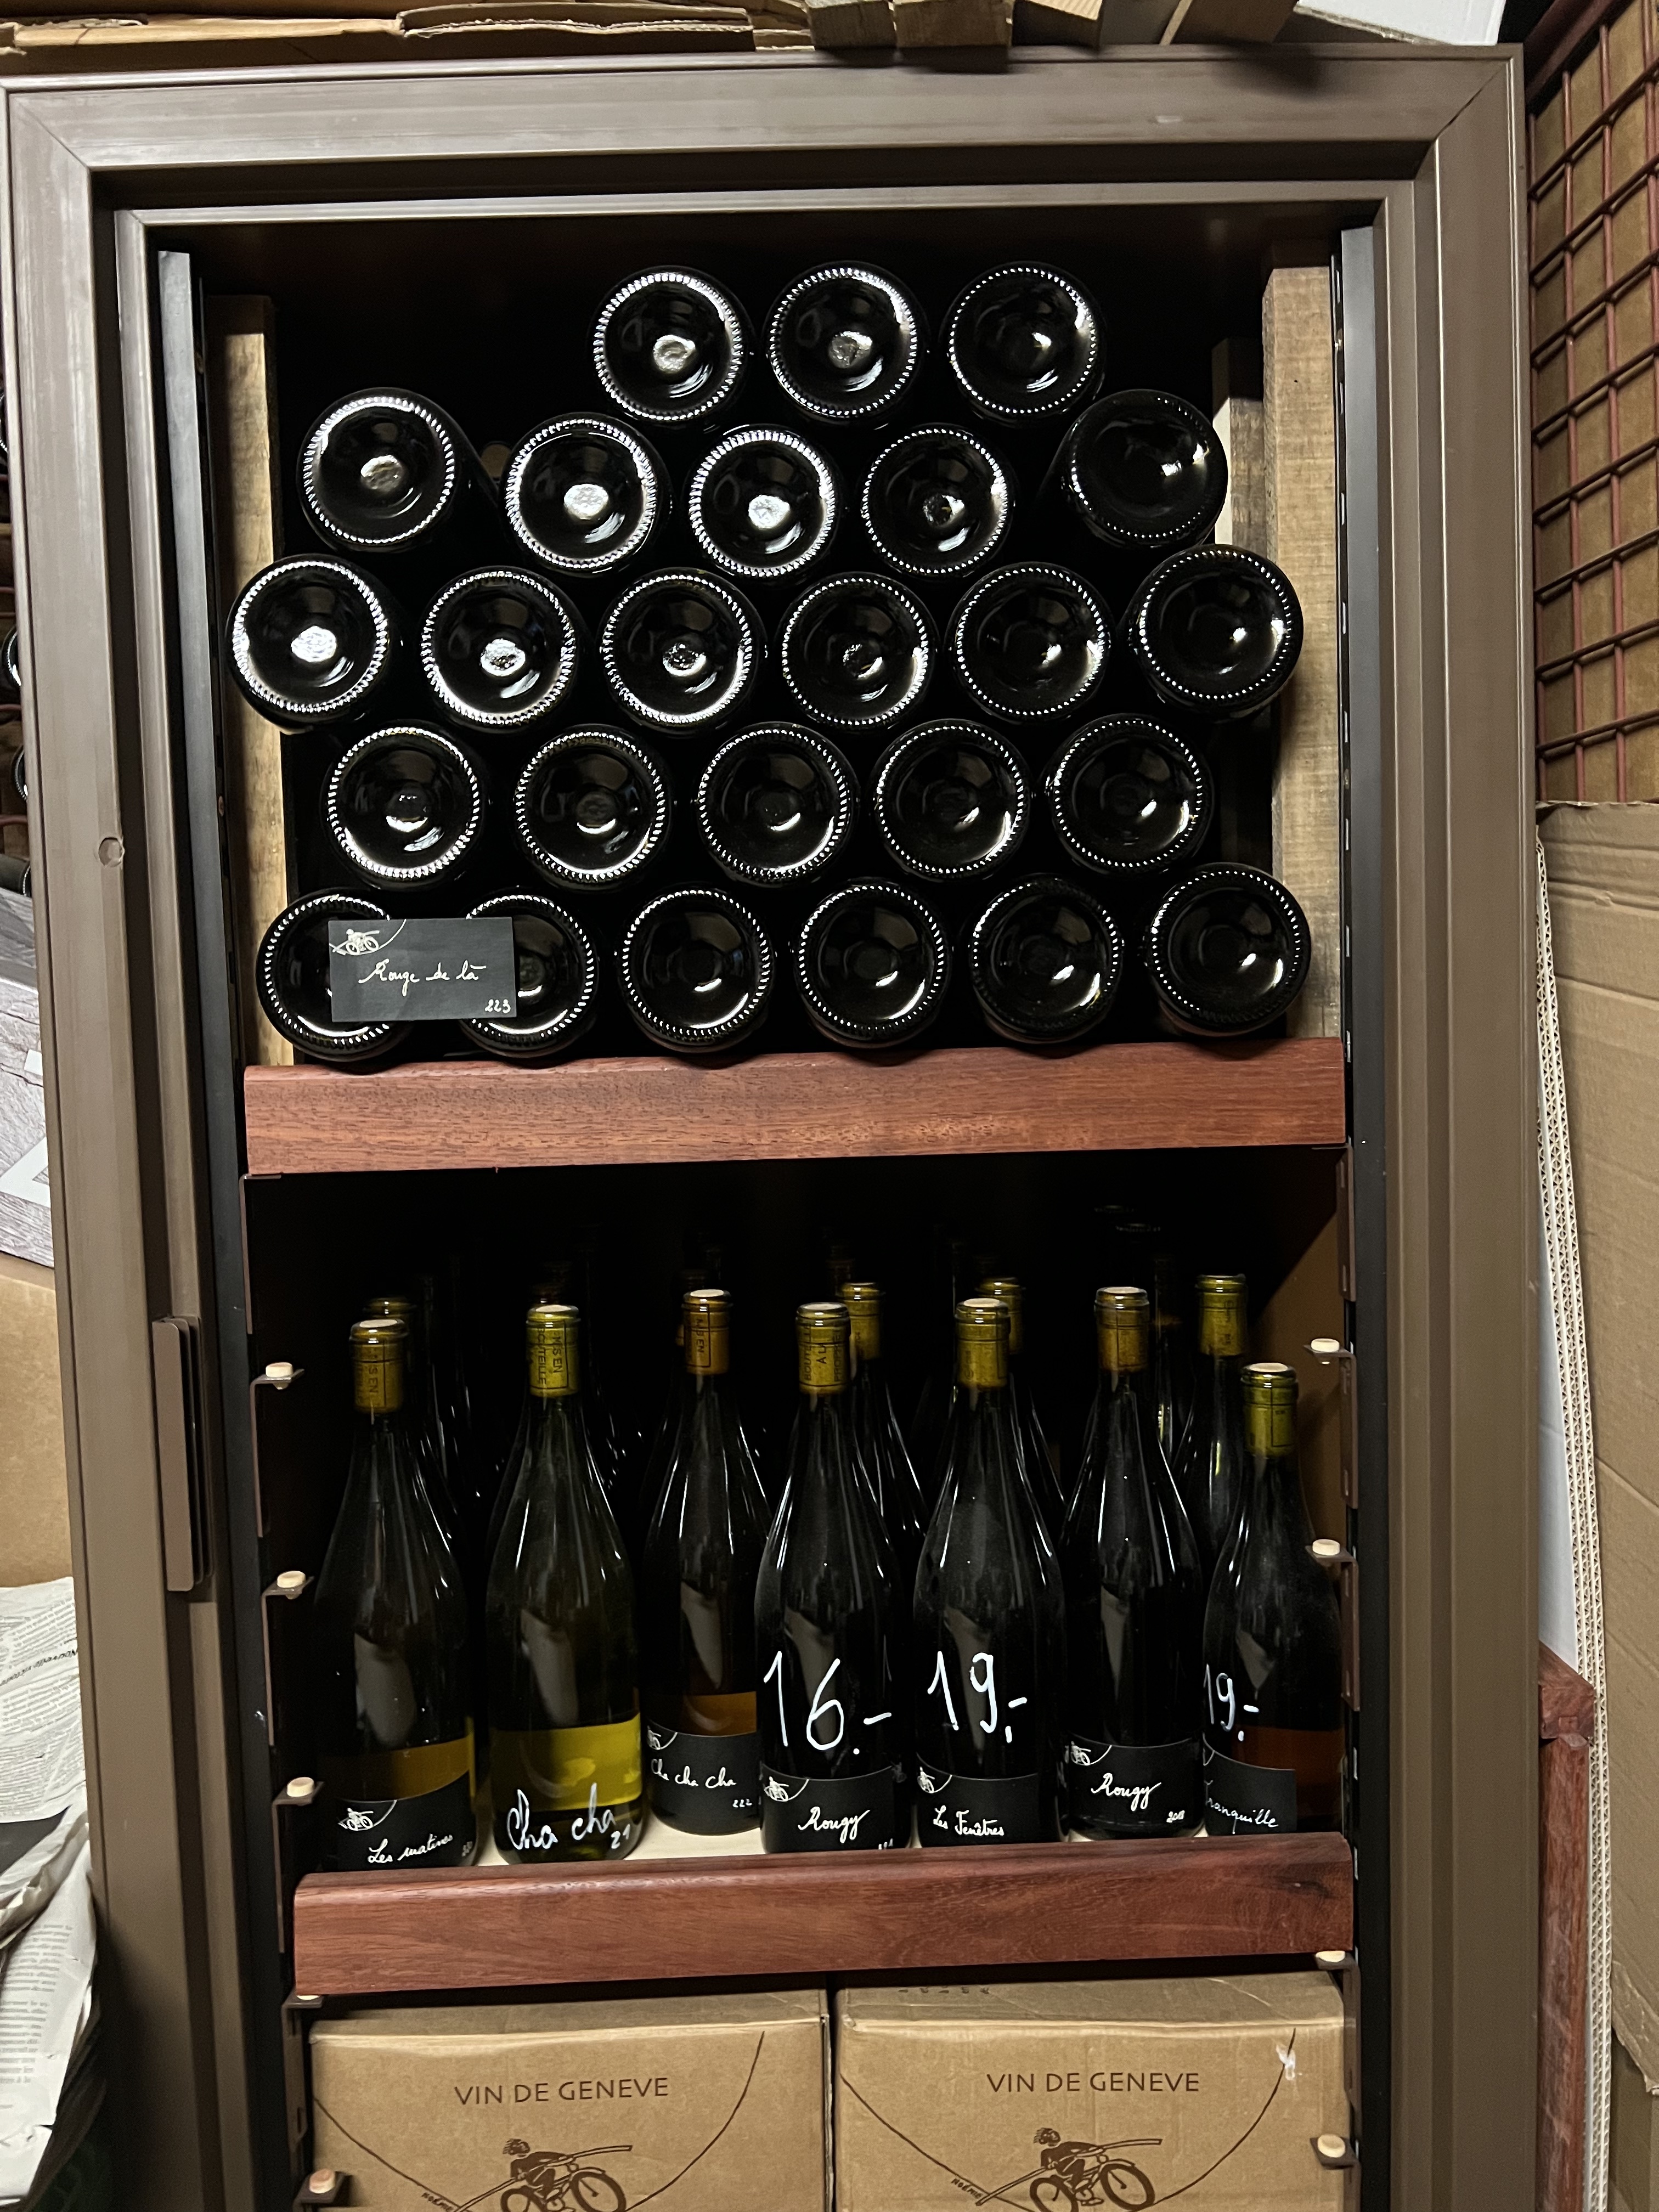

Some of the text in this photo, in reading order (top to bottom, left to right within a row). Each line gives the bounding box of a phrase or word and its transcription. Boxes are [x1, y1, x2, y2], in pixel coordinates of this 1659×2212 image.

[358, 958, 420, 997] Rouge
[425, 962, 450, 981] de
[484, 999, 511, 1014] 223
[552, 1358, 563, 1373] EN
[367, 1838, 393, 1864] Les
[454, 2078, 669, 2106] VIN DE GENEVE
[986, 2072, 1199, 2092] VIN DE GENEVE
